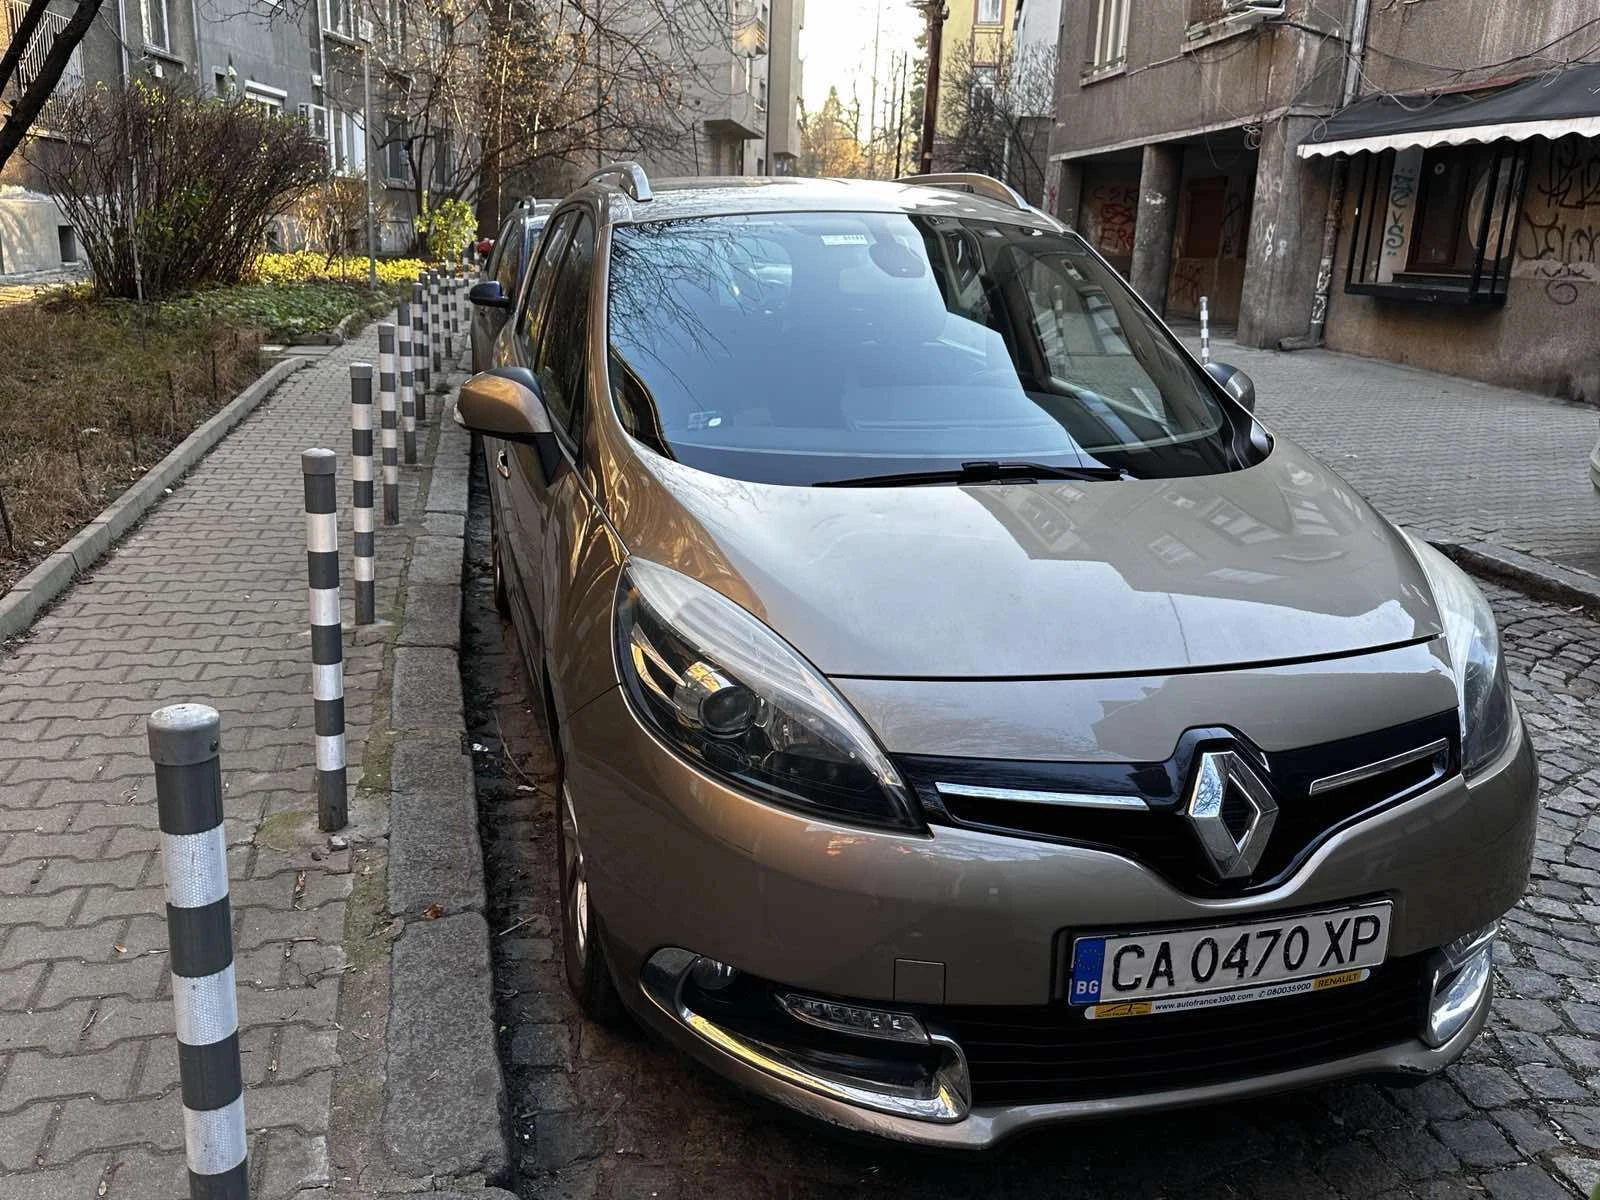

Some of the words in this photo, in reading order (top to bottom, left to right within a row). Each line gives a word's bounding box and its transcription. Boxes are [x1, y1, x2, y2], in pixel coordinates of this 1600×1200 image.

[1112, 941, 1175, 992] CA
[1191, 925, 1309, 983] 0470
[1318, 914, 1381, 968] XP
[1076, 980, 1099, 995] BG
[1318, 973, 1358, 987] RENAULT
